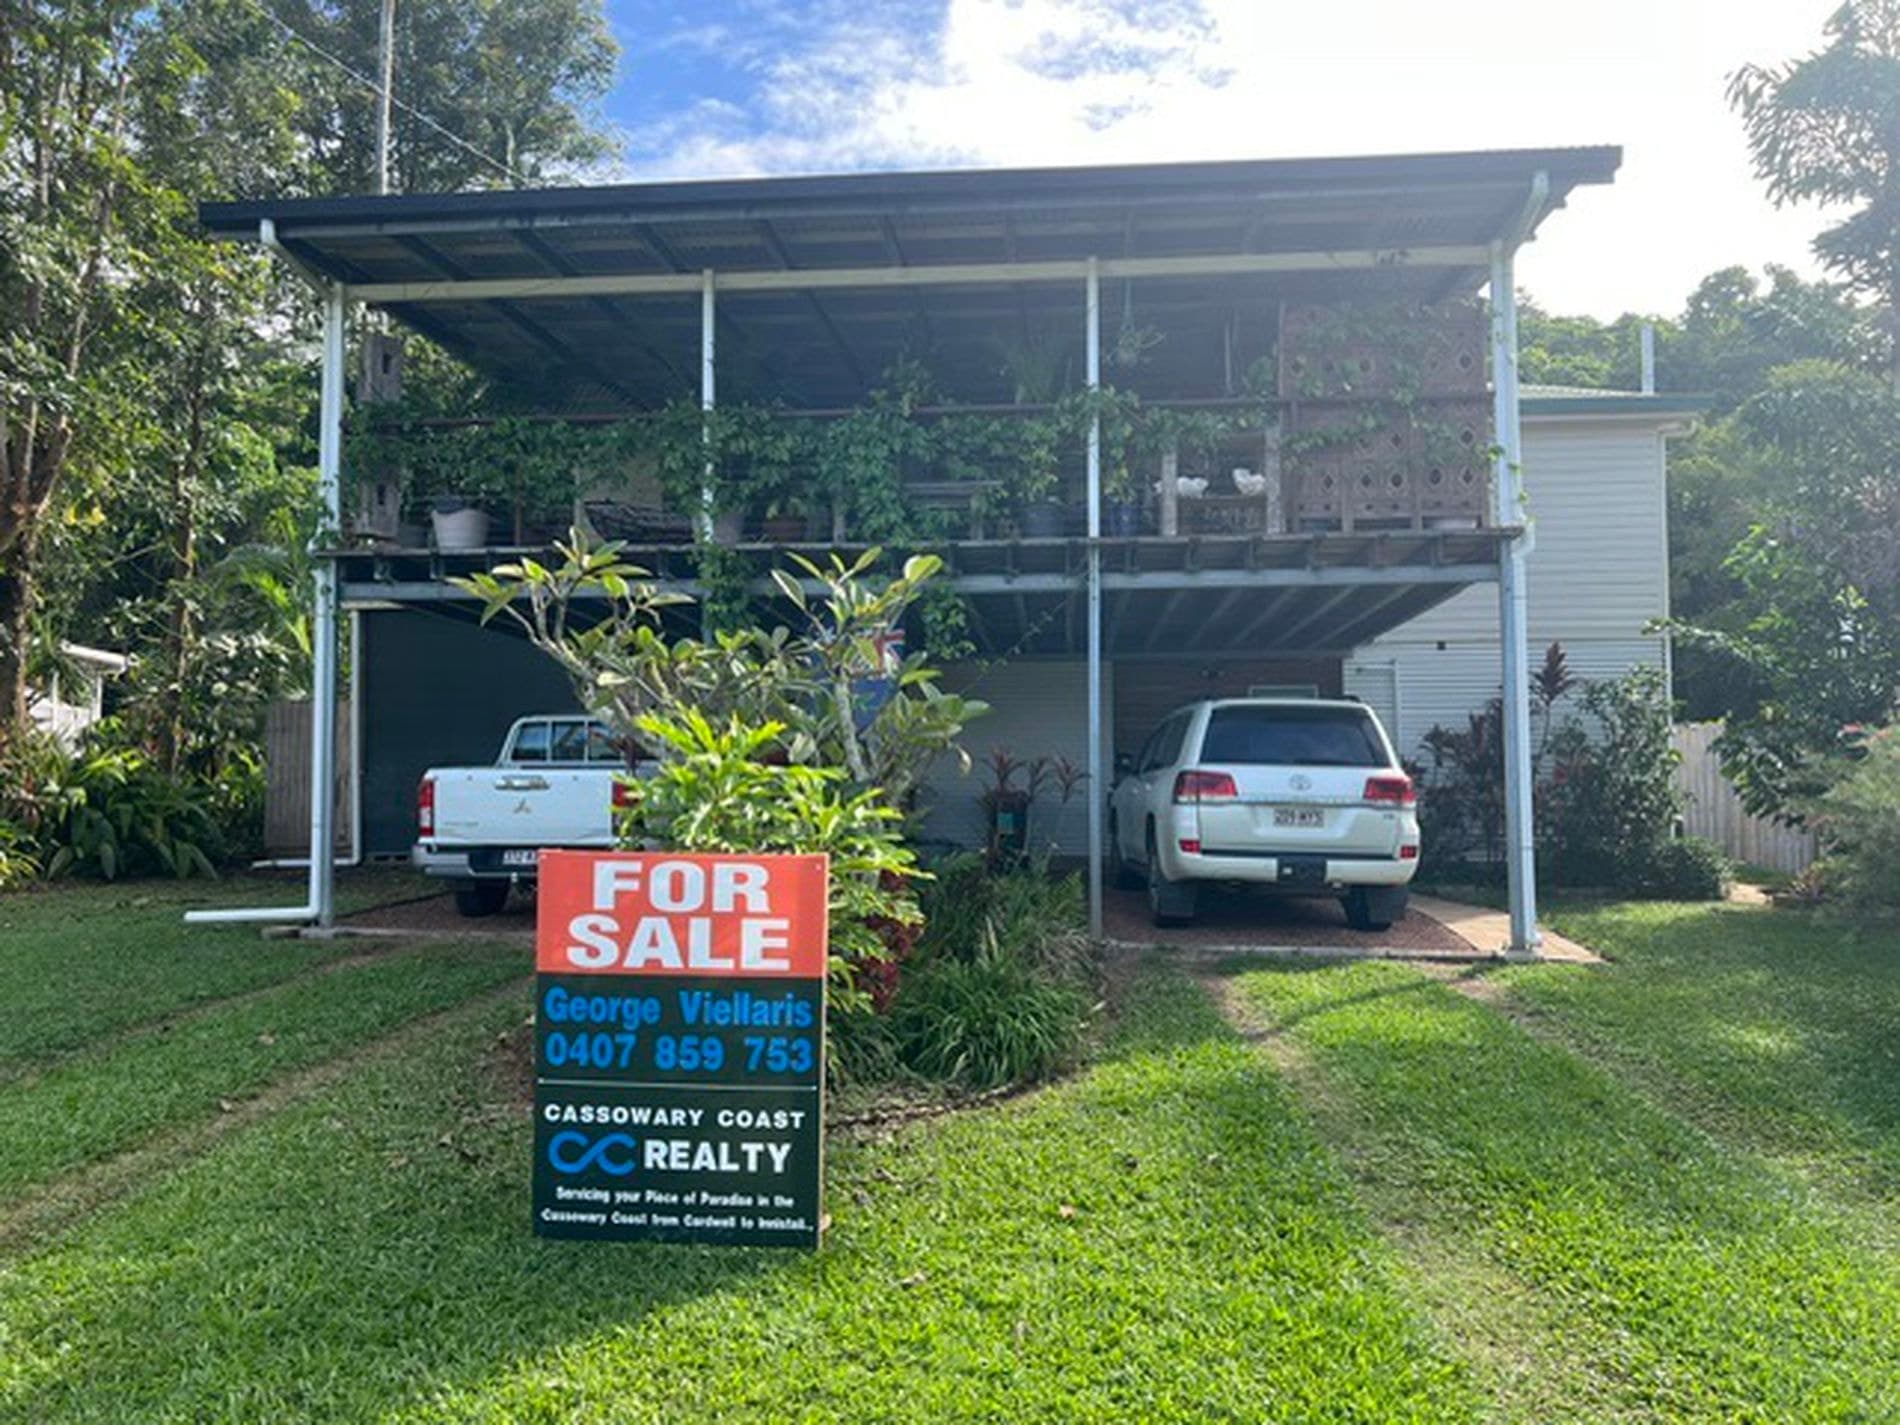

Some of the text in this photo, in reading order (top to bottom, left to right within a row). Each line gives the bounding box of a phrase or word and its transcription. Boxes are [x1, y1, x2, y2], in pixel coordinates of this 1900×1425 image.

[592, 859, 771, 914] FOR
[566, 912, 792, 972] SALE
[544, 987, 814, 1031] George Viellaris
[544, 1031, 813, 1073] 0407 859 753
[544, 1104, 806, 1129] CASSOWARY COAST
[643, 1139, 792, 1173] REALTY
[556, 1186, 795, 1208] Servicing your Piece of Paradise in the
[541, 1207, 608, 1226] Cassowary
[611, 1210, 648, 1225] Coast
[651, 1212, 680, 1227] from
[683, 1213, 737, 1228] Cardwell
[740, 1215, 755, 1230] to
